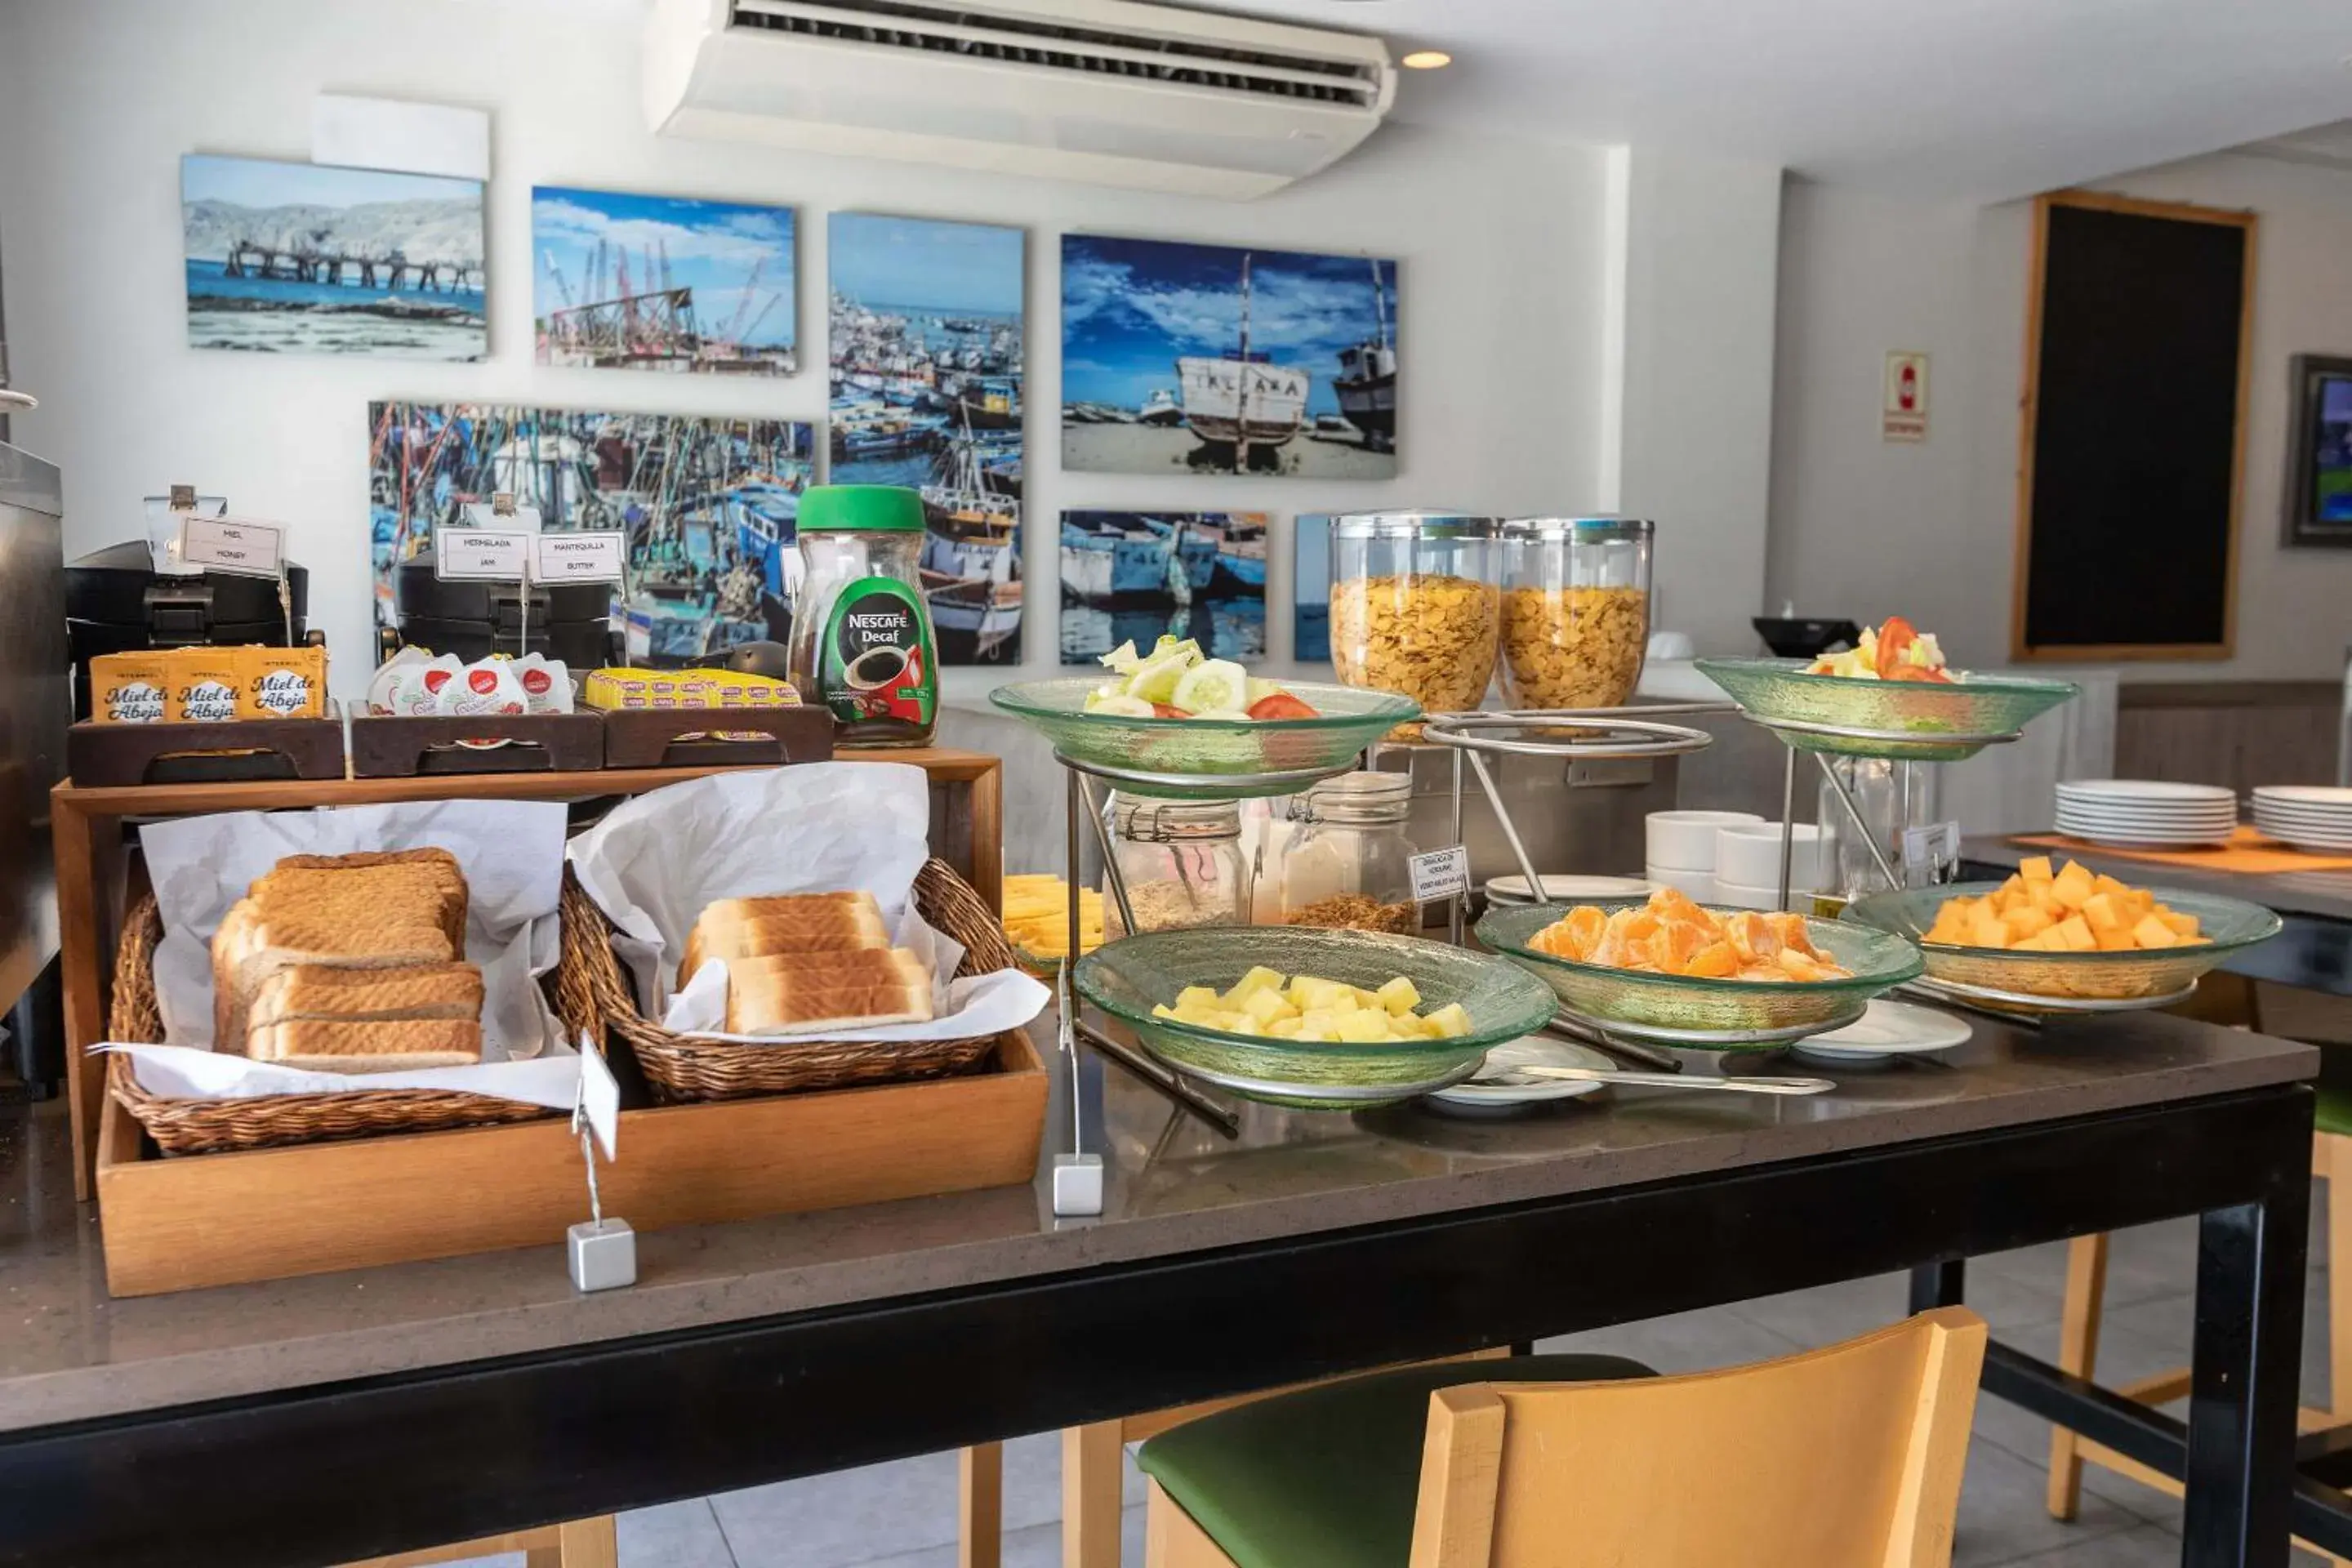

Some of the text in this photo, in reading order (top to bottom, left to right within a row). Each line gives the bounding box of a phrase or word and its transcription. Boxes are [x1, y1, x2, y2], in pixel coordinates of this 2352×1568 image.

[223, 530, 243, 539] MIEL
[464, 539, 511, 547] MERMELADA
[554, 543, 604, 551] MANTEQUILLA
[216, 550, 246, 559] HONEY
[480, 559, 496, 567] JAM
[567, 562, 595, 570] BUTTER
[862, 630, 899, 644] Decaf
[250, 674, 315, 693] Miel de
[104, 687, 151, 705] Miel
[176, 686, 224, 703] Miel
[254, 692, 308, 711] Abeja
[108, 703, 163, 721] Abeja
[180, 703, 234, 721] Abeja
